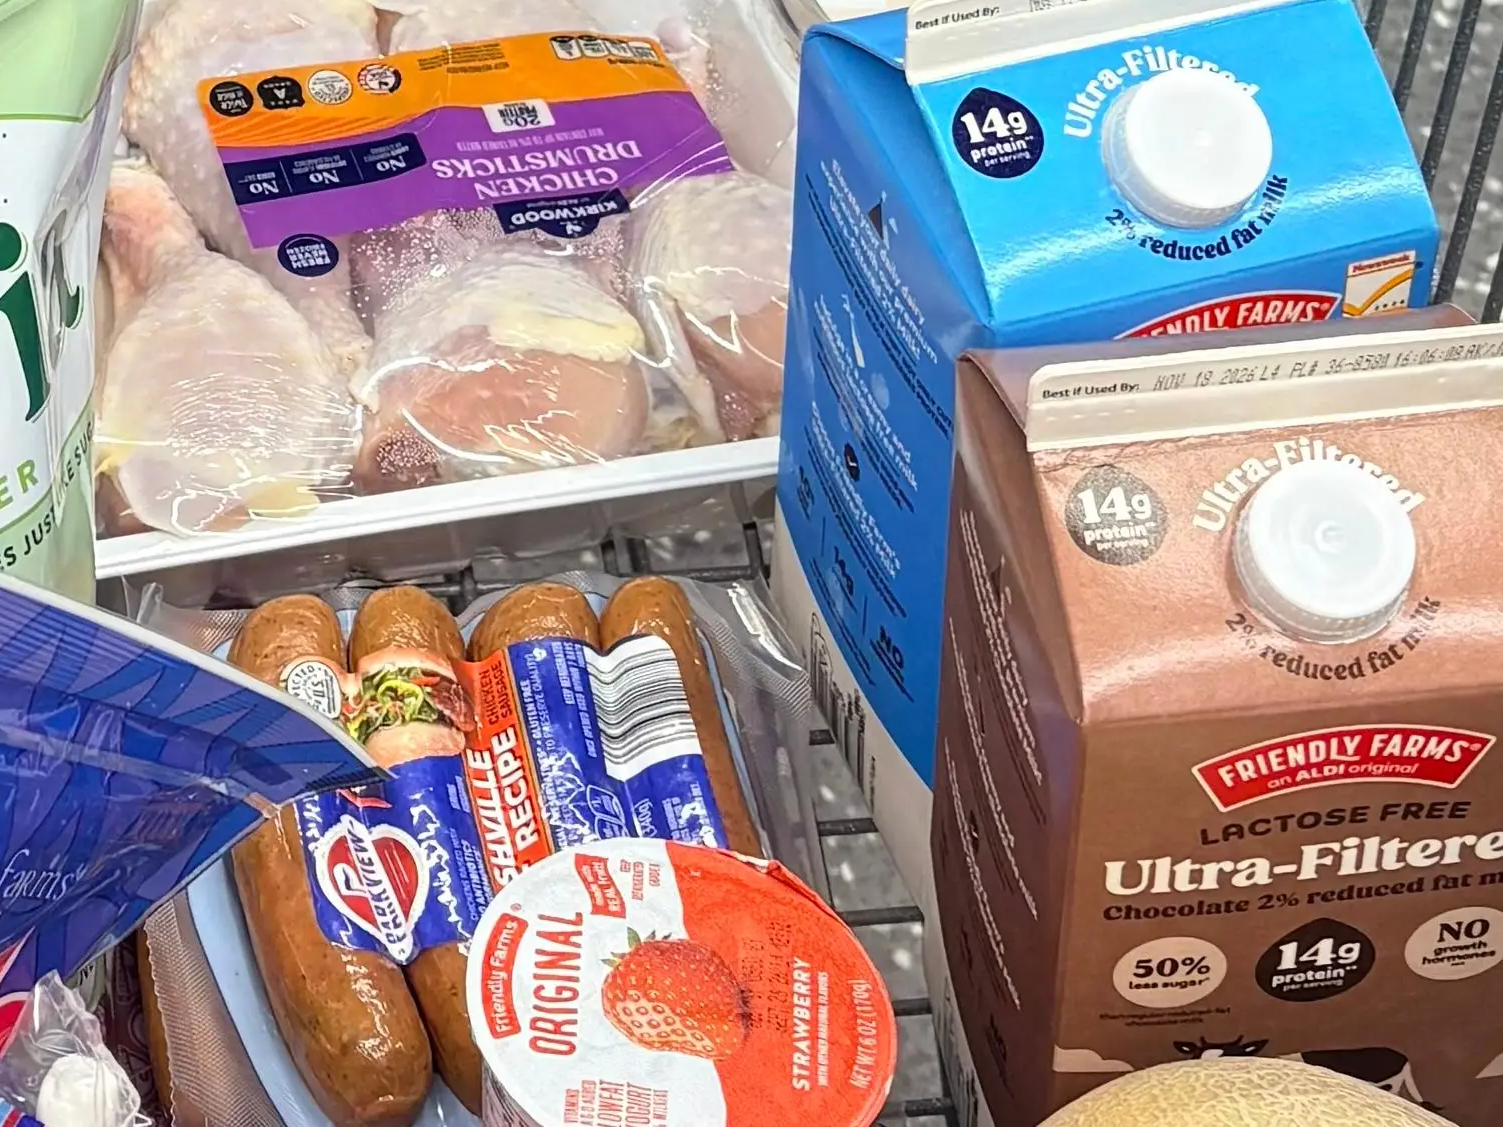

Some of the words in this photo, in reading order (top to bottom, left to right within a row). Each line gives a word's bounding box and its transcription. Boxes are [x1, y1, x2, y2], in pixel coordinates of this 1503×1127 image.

[915, 16, 940, 30] Best
[950, 10, 981, 24] Used
[982, 6, 1001, 20] By:
[502, 114, 541, 128] 20g
[960, 105, 1028, 143] 14g
[376, 156, 407, 173] No
[431, 138, 643, 179] DRUMSTICKS
[248, 179, 279, 195] No
[308, 169, 340, 185] No
[473, 166, 619, 201] CHICKEN
[510, 197, 619, 226] KIRKWOOD
[1104, 208, 1137, 241] 2%
[1137, 234, 1233, 261] reduced
[1230, 219, 1263, 250] fat
[1257, 174, 1289, 226] milk
[1351, 253, 1412, 273] Newsweek
[1235, 301, 1321, 326] FARMS
[1041, 388, 1070, 399] Best
[1084, 384, 1117, 396] Used
[1120, 383, 1140, 394] By:
[1152, 374, 1184, 391] NOV
[1193, 370, 1213, 387] 18
[1218, 366, 1255, 386] 2026
[1081, 487, 1153, 525] 14g
[1083, 524, 1146, 544] protein
[1224, 611, 1257, 650] 2%
[1257, 639, 1366, 682] reduced
[1366, 637, 1406, 677] fat
[1401, 594, 1443, 654] milk
[478, 668, 502, 726] CHICKEN
[490, 659, 513, 720] SAUSAGE
[520, 678, 535, 702] FREE
[527, 701, 544, 739] GLUTEN
[1216, 733, 1362, 789] FRIENDLY
[1368, 733, 1473, 763] FARMS
[490, 725, 541, 852] RECIPE
[1266, 772, 1293, 790] an
[1294, 763, 1346, 782] ALDI
[1347, 761, 1419, 776] original
[632, 797, 658, 838] (340g)
[1200, 804, 1370, 846] LACTOSE
[1378, 800, 1472, 823] FREE
[1101, 895, 1251, 923] Chocolate
[1256, 890, 1301, 911] 2%
[1306, 876, 1426, 906] reduced
[1431, 871, 1474, 891] fat
[487, 917, 520, 968] Farms
[1436, 917, 1491, 945] NO
[1275, 937, 1362, 971] 14g
[1421, 949, 1497, 968] hormones
[1432, 940, 1488, 956] growth
[1131, 954, 1212, 979] 50%
[1271, 966, 1348, 990] protein
[527, 911, 585, 1057] ORIGINAL
[1127, 979, 1160, 993] less
[1302, 977, 1344, 990] serving
[483, 969, 513, 1035] Friendly
[790, 956, 814, 1093] STRAWBERRY
[853, 1019, 877, 1037] OZ
[853, 1046, 877, 1066] WT
[850, 1065, 873, 1089] NET
